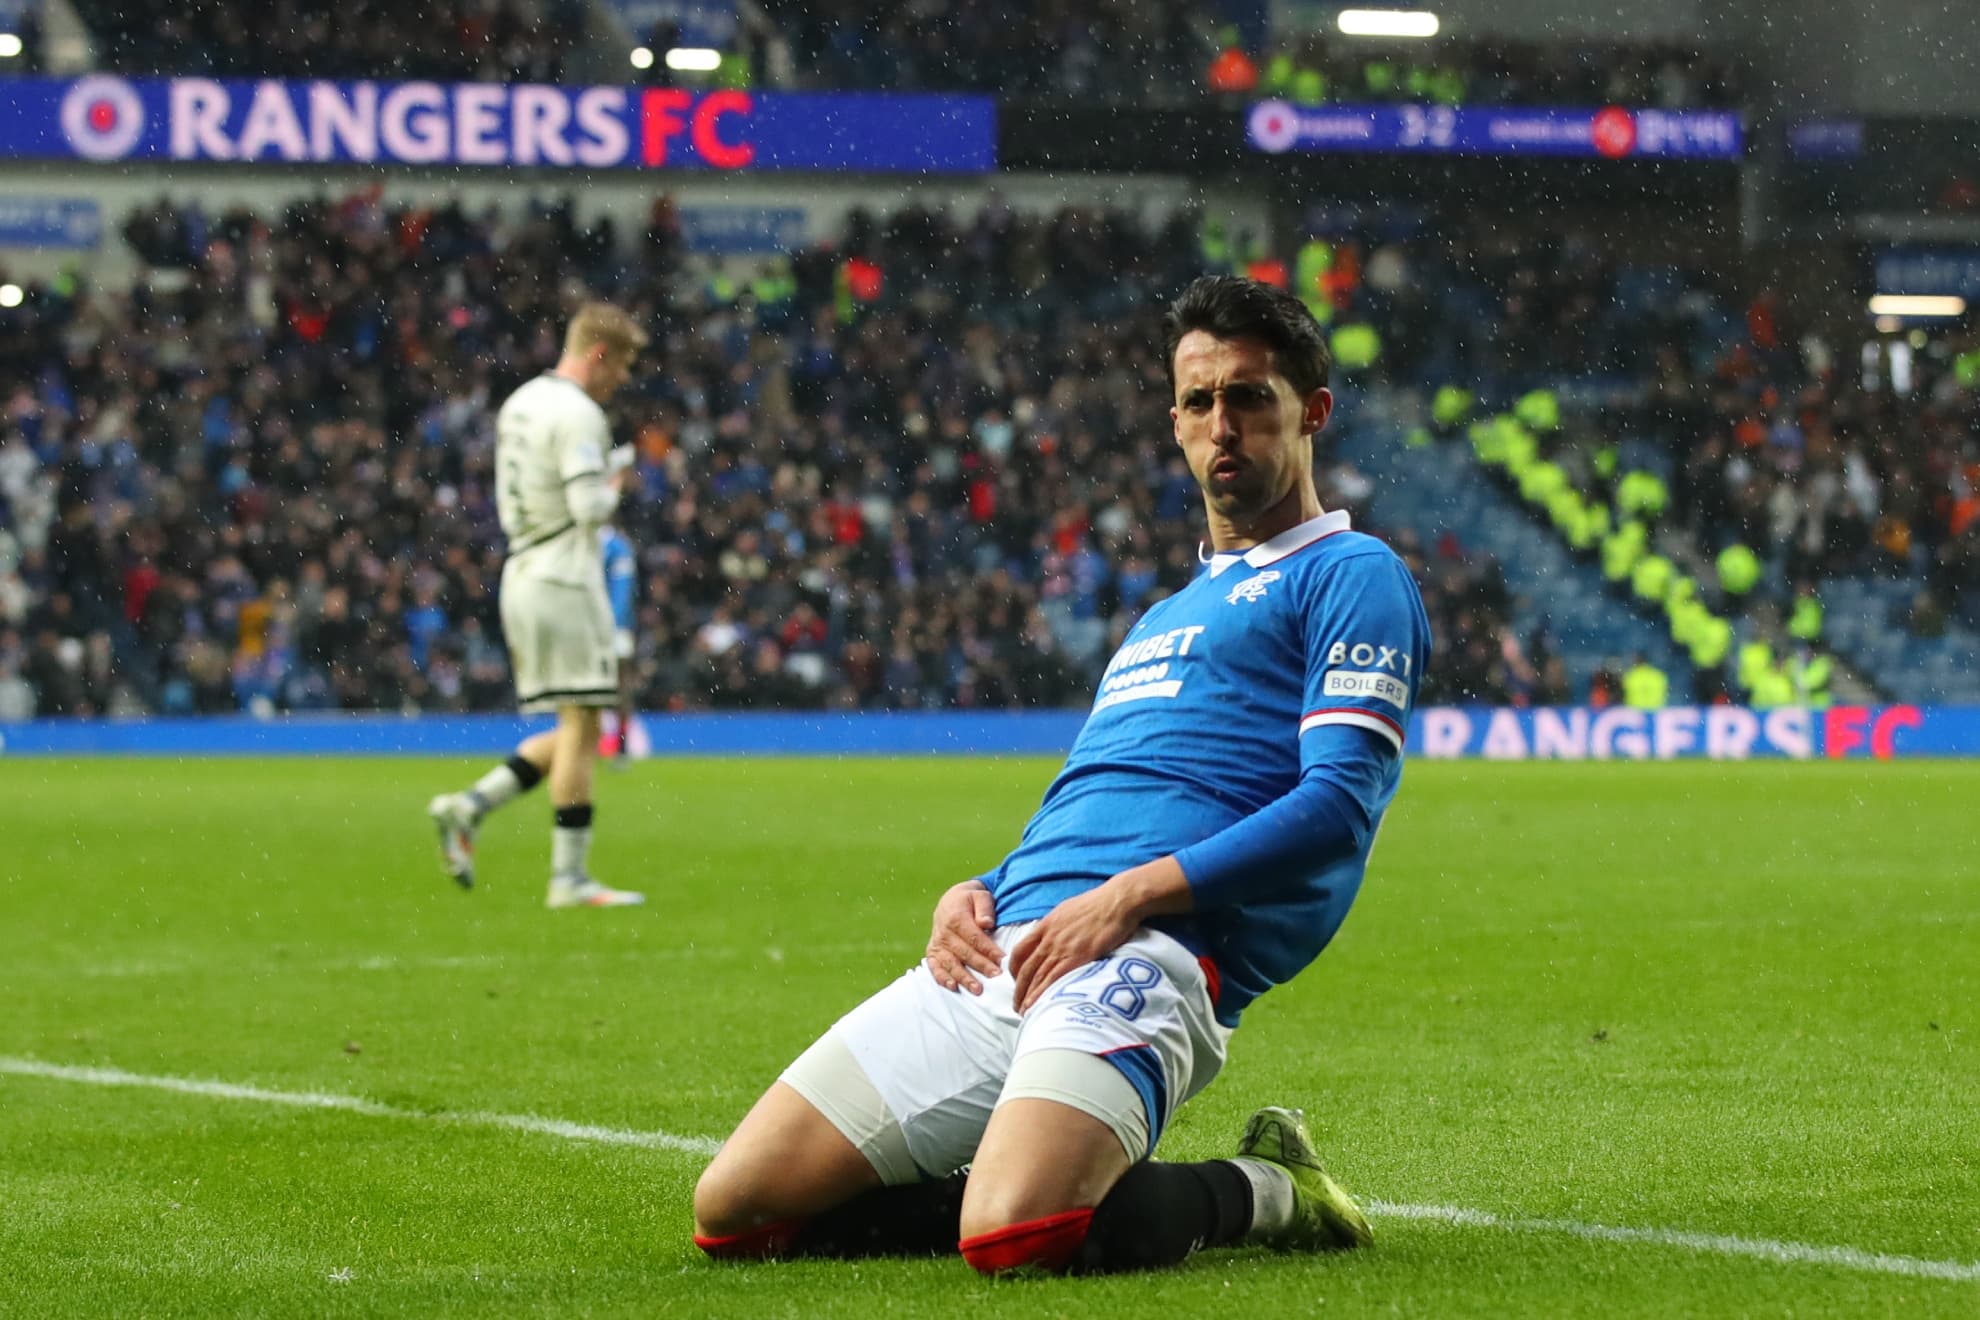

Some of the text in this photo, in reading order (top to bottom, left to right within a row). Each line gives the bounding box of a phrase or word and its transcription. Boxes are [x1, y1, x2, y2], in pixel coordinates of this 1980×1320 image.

[168, 79, 756, 168] RANGERS FC
[1331, 677, 1403, 701] BOILERS
[1422, 705, 1923, 760] RANGERS FC
